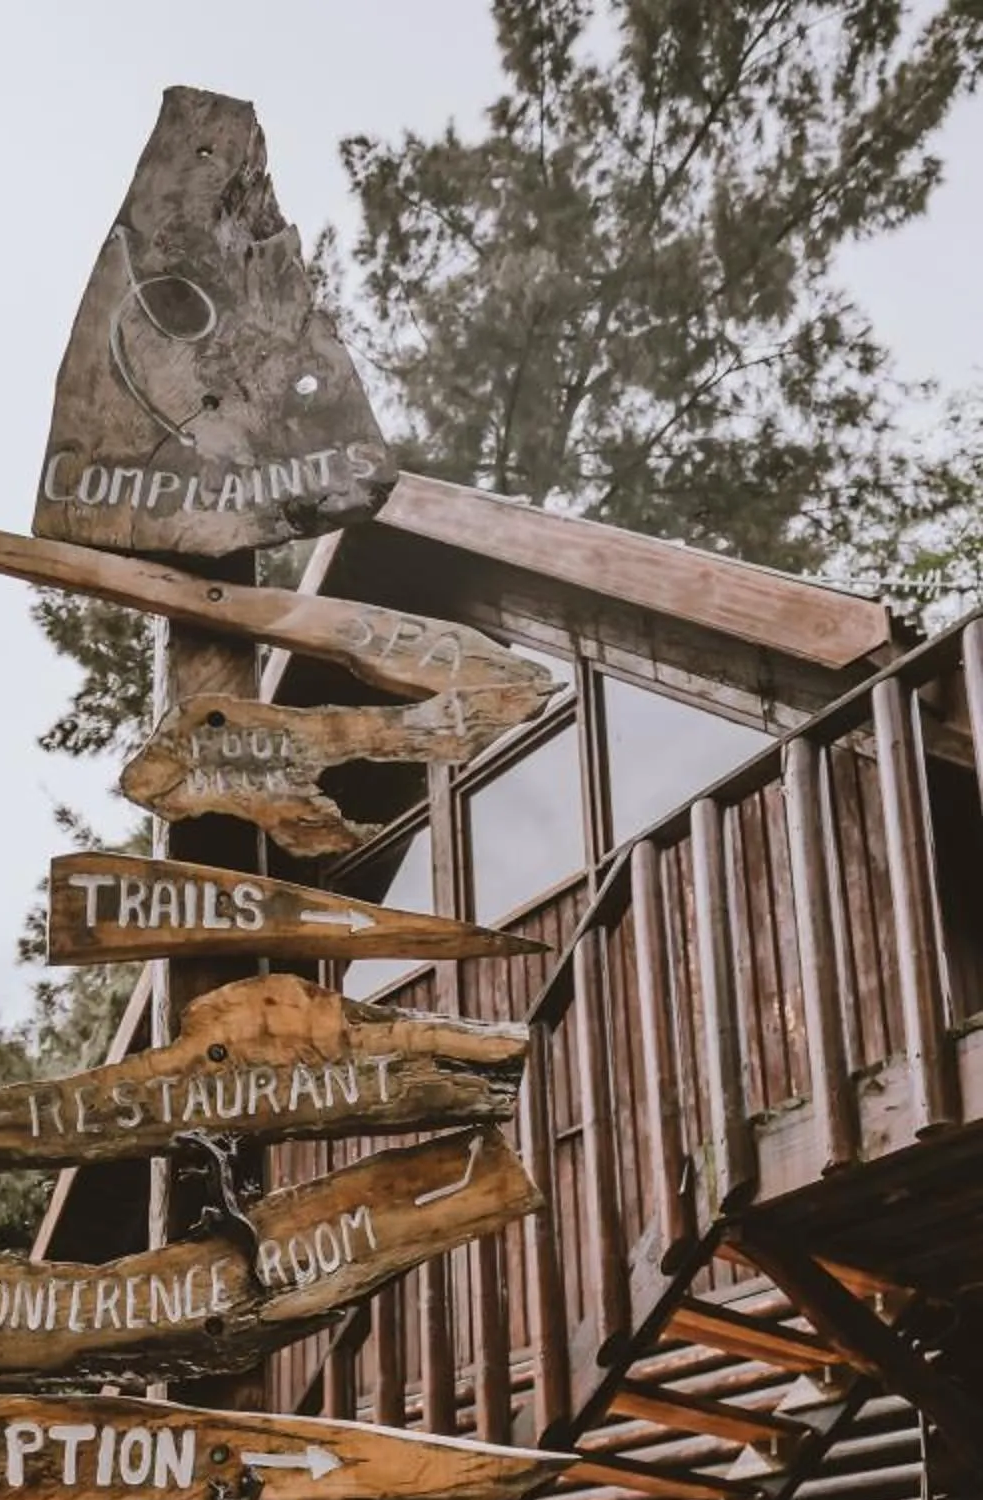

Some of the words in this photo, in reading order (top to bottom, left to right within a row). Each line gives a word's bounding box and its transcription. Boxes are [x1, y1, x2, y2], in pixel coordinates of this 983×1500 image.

[43, 446, 377, 513] COMPLAINTS
[68, 873, 266, 931] TRAILS
[27, 1053, 402, 1138] RESTAURANT
[256, 1205, 377, 1288] ROOM
